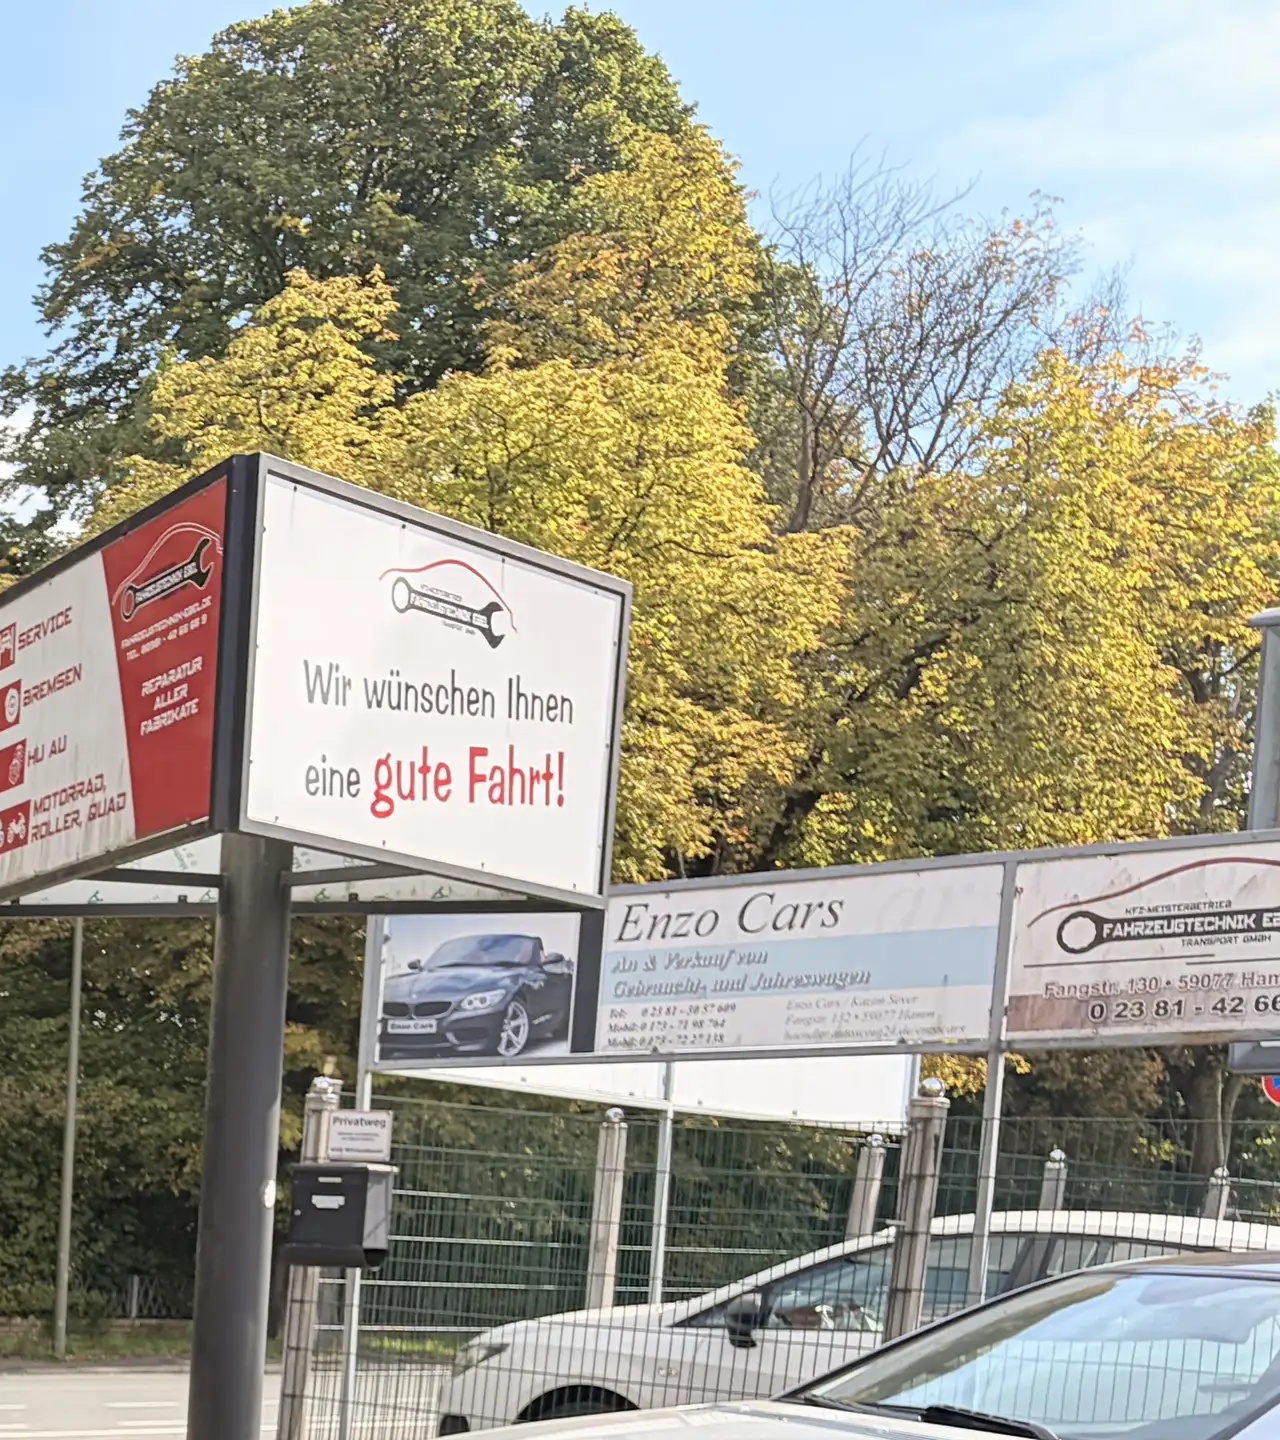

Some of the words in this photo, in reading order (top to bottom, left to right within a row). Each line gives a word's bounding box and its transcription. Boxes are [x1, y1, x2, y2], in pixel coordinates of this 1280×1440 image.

[18, 606, 72, 651] SERVICE
[23, 663, 83, 708] BREMSEN
[141, 655, 203, 697] REPARATUR
[303, 659, 352, 706] Wir
[363, 669, 495, 719] wünschen
[507, 674, 574, 724] Ihnen
[153, 683, 188, 711] ALLER
[140, 698, 199, 736] FABRIKATE
[27, 744, 45, 768] HU
[48, 734, 67, 758] AU
[33, 773, 107, 817] MOTORRAD,
[305, 753, 361, 798] eine
[370, 746, 453, 819] gute
[468, 744, 565, 808] Fahrt!
[30, 809, 83, 843] ROLLER,
[87, 792, 127, 822] QUAD
[614, 902, 720, 943] Enzo
[738, 891, 845, 935] Cars
[1125, 899, 1233, 916] KFZ-MEISTERBETRIEB
[1102, 912, 1258, 939] FAHRZEUGTECHNIK
[1181, 936, 1239, 948] TRANSPORT
[611, 955, 639, 975] An
[664, 949, 737, 972] Verkauf
[737, 950, 770, 967] von
[710, 977, 747, 994] und
[749, 970, 872, 992] Jahreswagen
[1043, 981, 1120, 999] Fangstr.
[1127, 975, 1160, 994] 130
[1177, 972, 1236, 992] 59077
[1090, 1002, 1106, 1020] 0
[1114, 1000, 1146, 1019] 23
[1154, 999, 1185, 1017] 81
[1211, 996, 1245, 1014] 42
[332, 1116, 387, 1130] Privatweg
